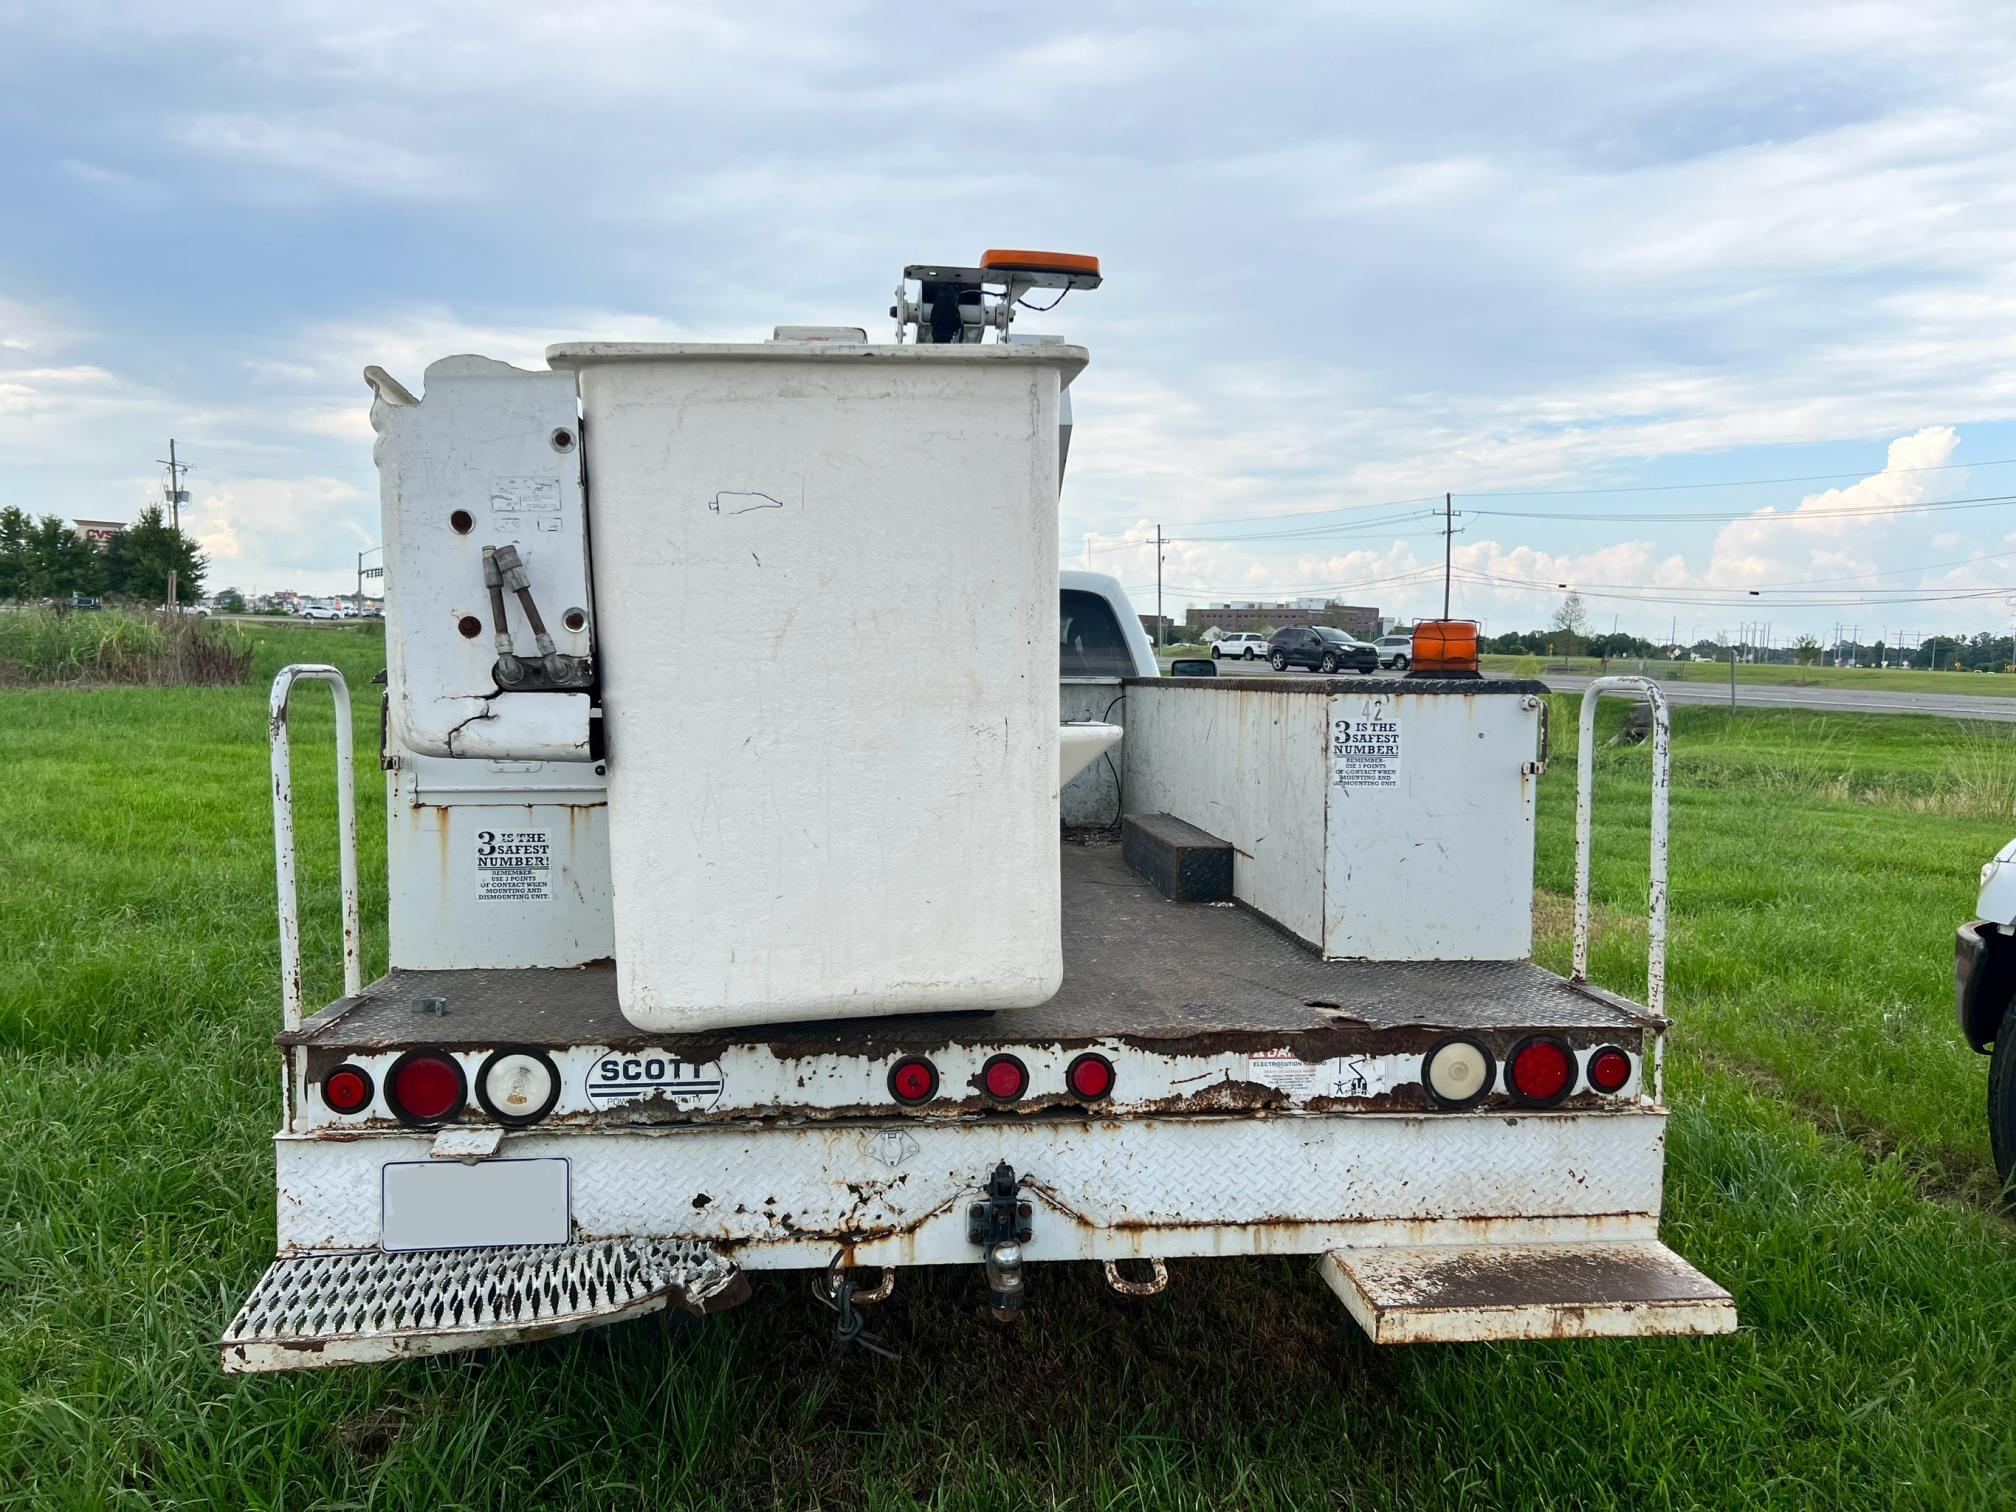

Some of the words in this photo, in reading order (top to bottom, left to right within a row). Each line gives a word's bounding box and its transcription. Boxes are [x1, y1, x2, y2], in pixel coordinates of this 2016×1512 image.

[1334, 720, 1351, 744] 3
[1355, 723, 1368, 732] IS
[1370, 723, 1397, 732] THE
[1352, 734, 1399, 743] SAFEST
[1334, 745, 1399, 755] NUMBER!
[477, 831, 496, 856] 3
[501, 833, 513, 843] IS
[516, 833, 546, 842] THE
[497, 845, 549, 855] SAFEST
[477, 857, 549, 867] NUMBER!
